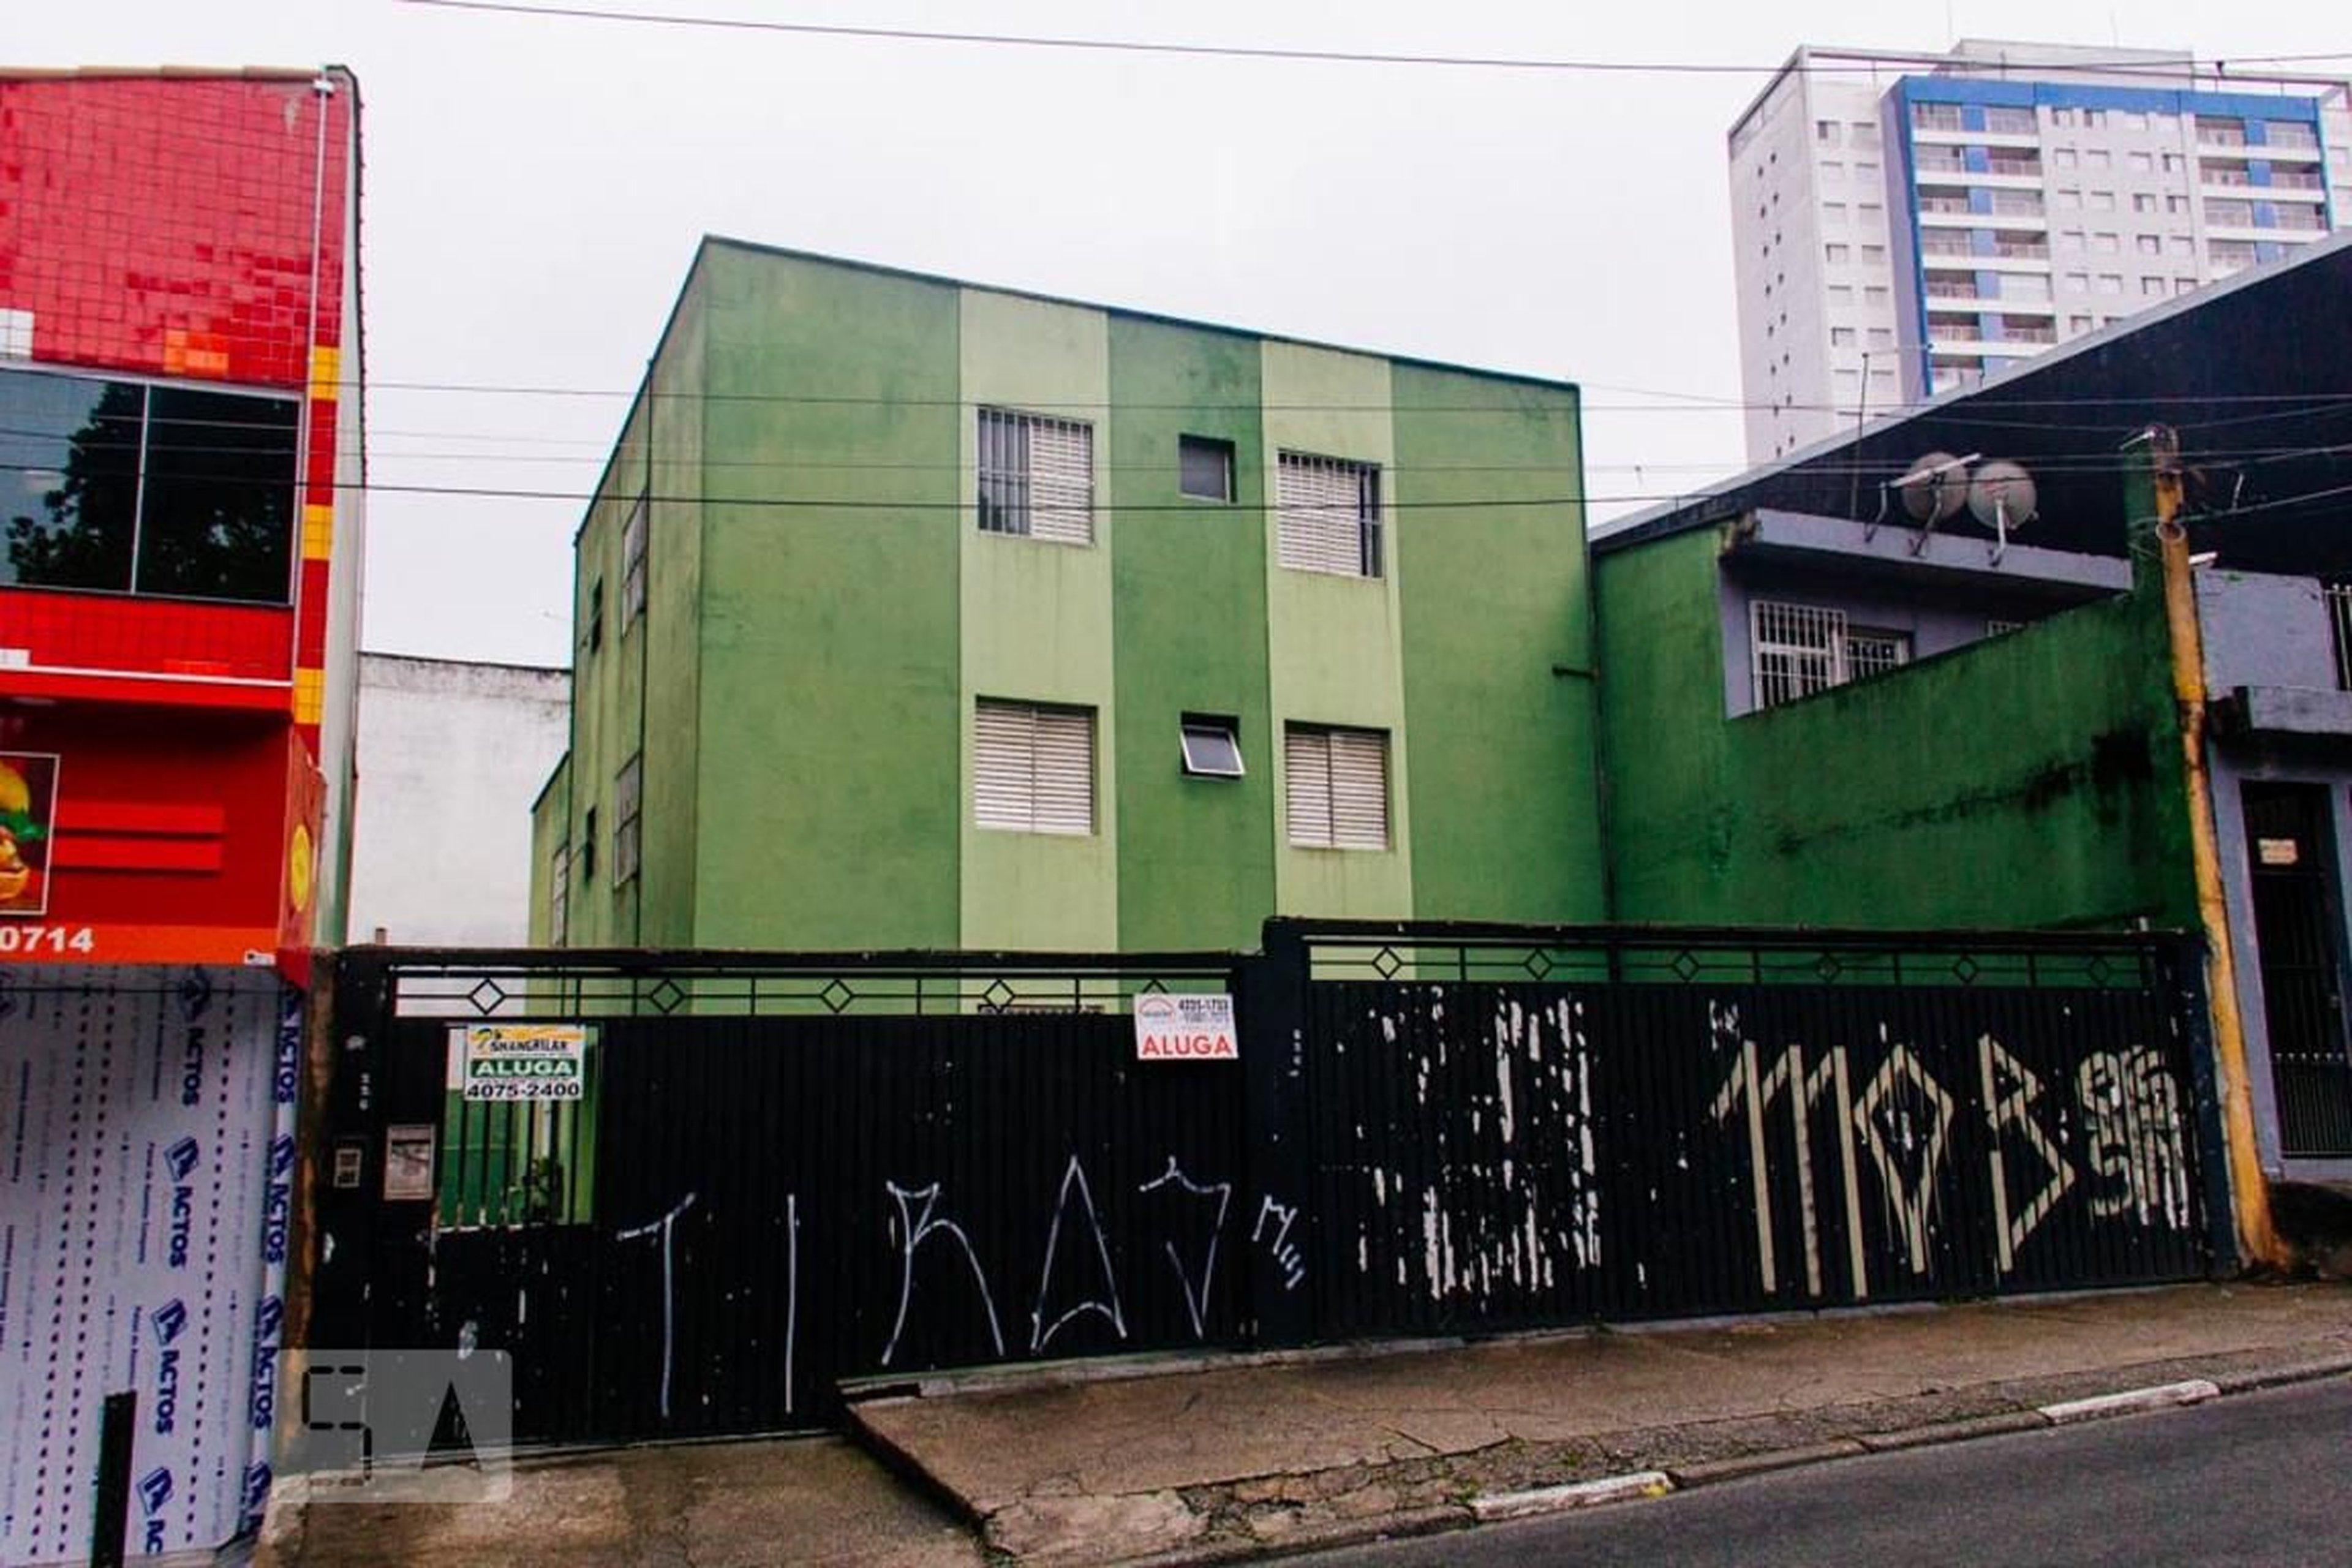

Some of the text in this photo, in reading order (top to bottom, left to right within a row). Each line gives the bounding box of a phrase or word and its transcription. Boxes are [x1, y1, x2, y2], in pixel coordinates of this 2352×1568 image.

[0, 926, 94, 952] 0714
[1142, 1035, 1232, 1055] ALUGA
[475, 1060, 573, 1076] ALUGA
[467, 1082, 579, 1097] 4075-2400
[169, 1185, 193, 1268] ACTOS
[156, 1349, 179, 1435] ACTOS
[254, 1346, 278, 1430] ACTOS
